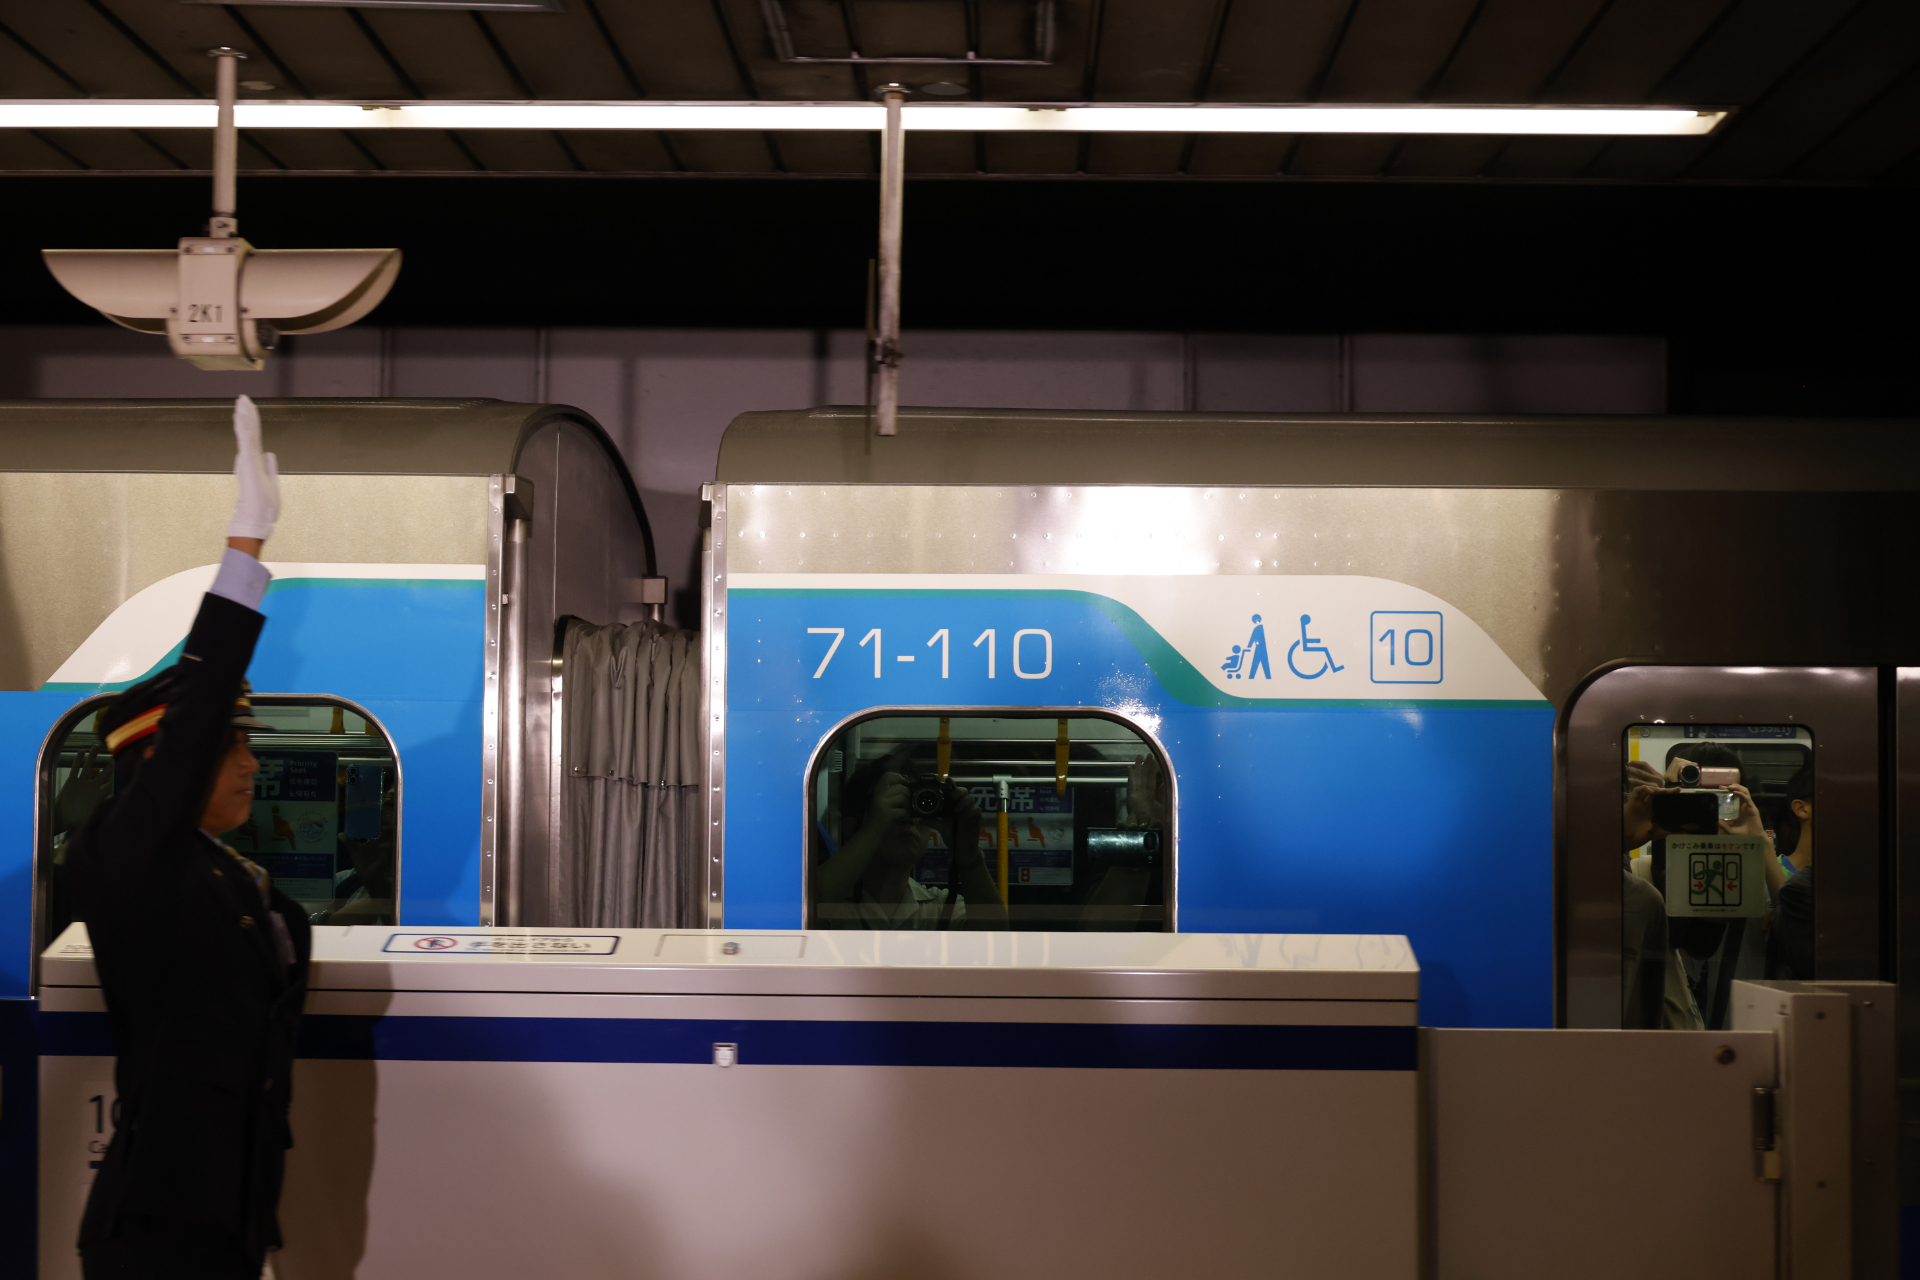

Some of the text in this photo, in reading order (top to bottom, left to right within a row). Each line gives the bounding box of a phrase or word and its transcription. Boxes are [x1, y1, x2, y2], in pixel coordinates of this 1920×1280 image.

[187, 303, 224, 323] 2K1
[806, 627, 1054, 680] 71-110
[1378, 628, 1434, 667] 10
[289, 760, 318, 768] Priority
